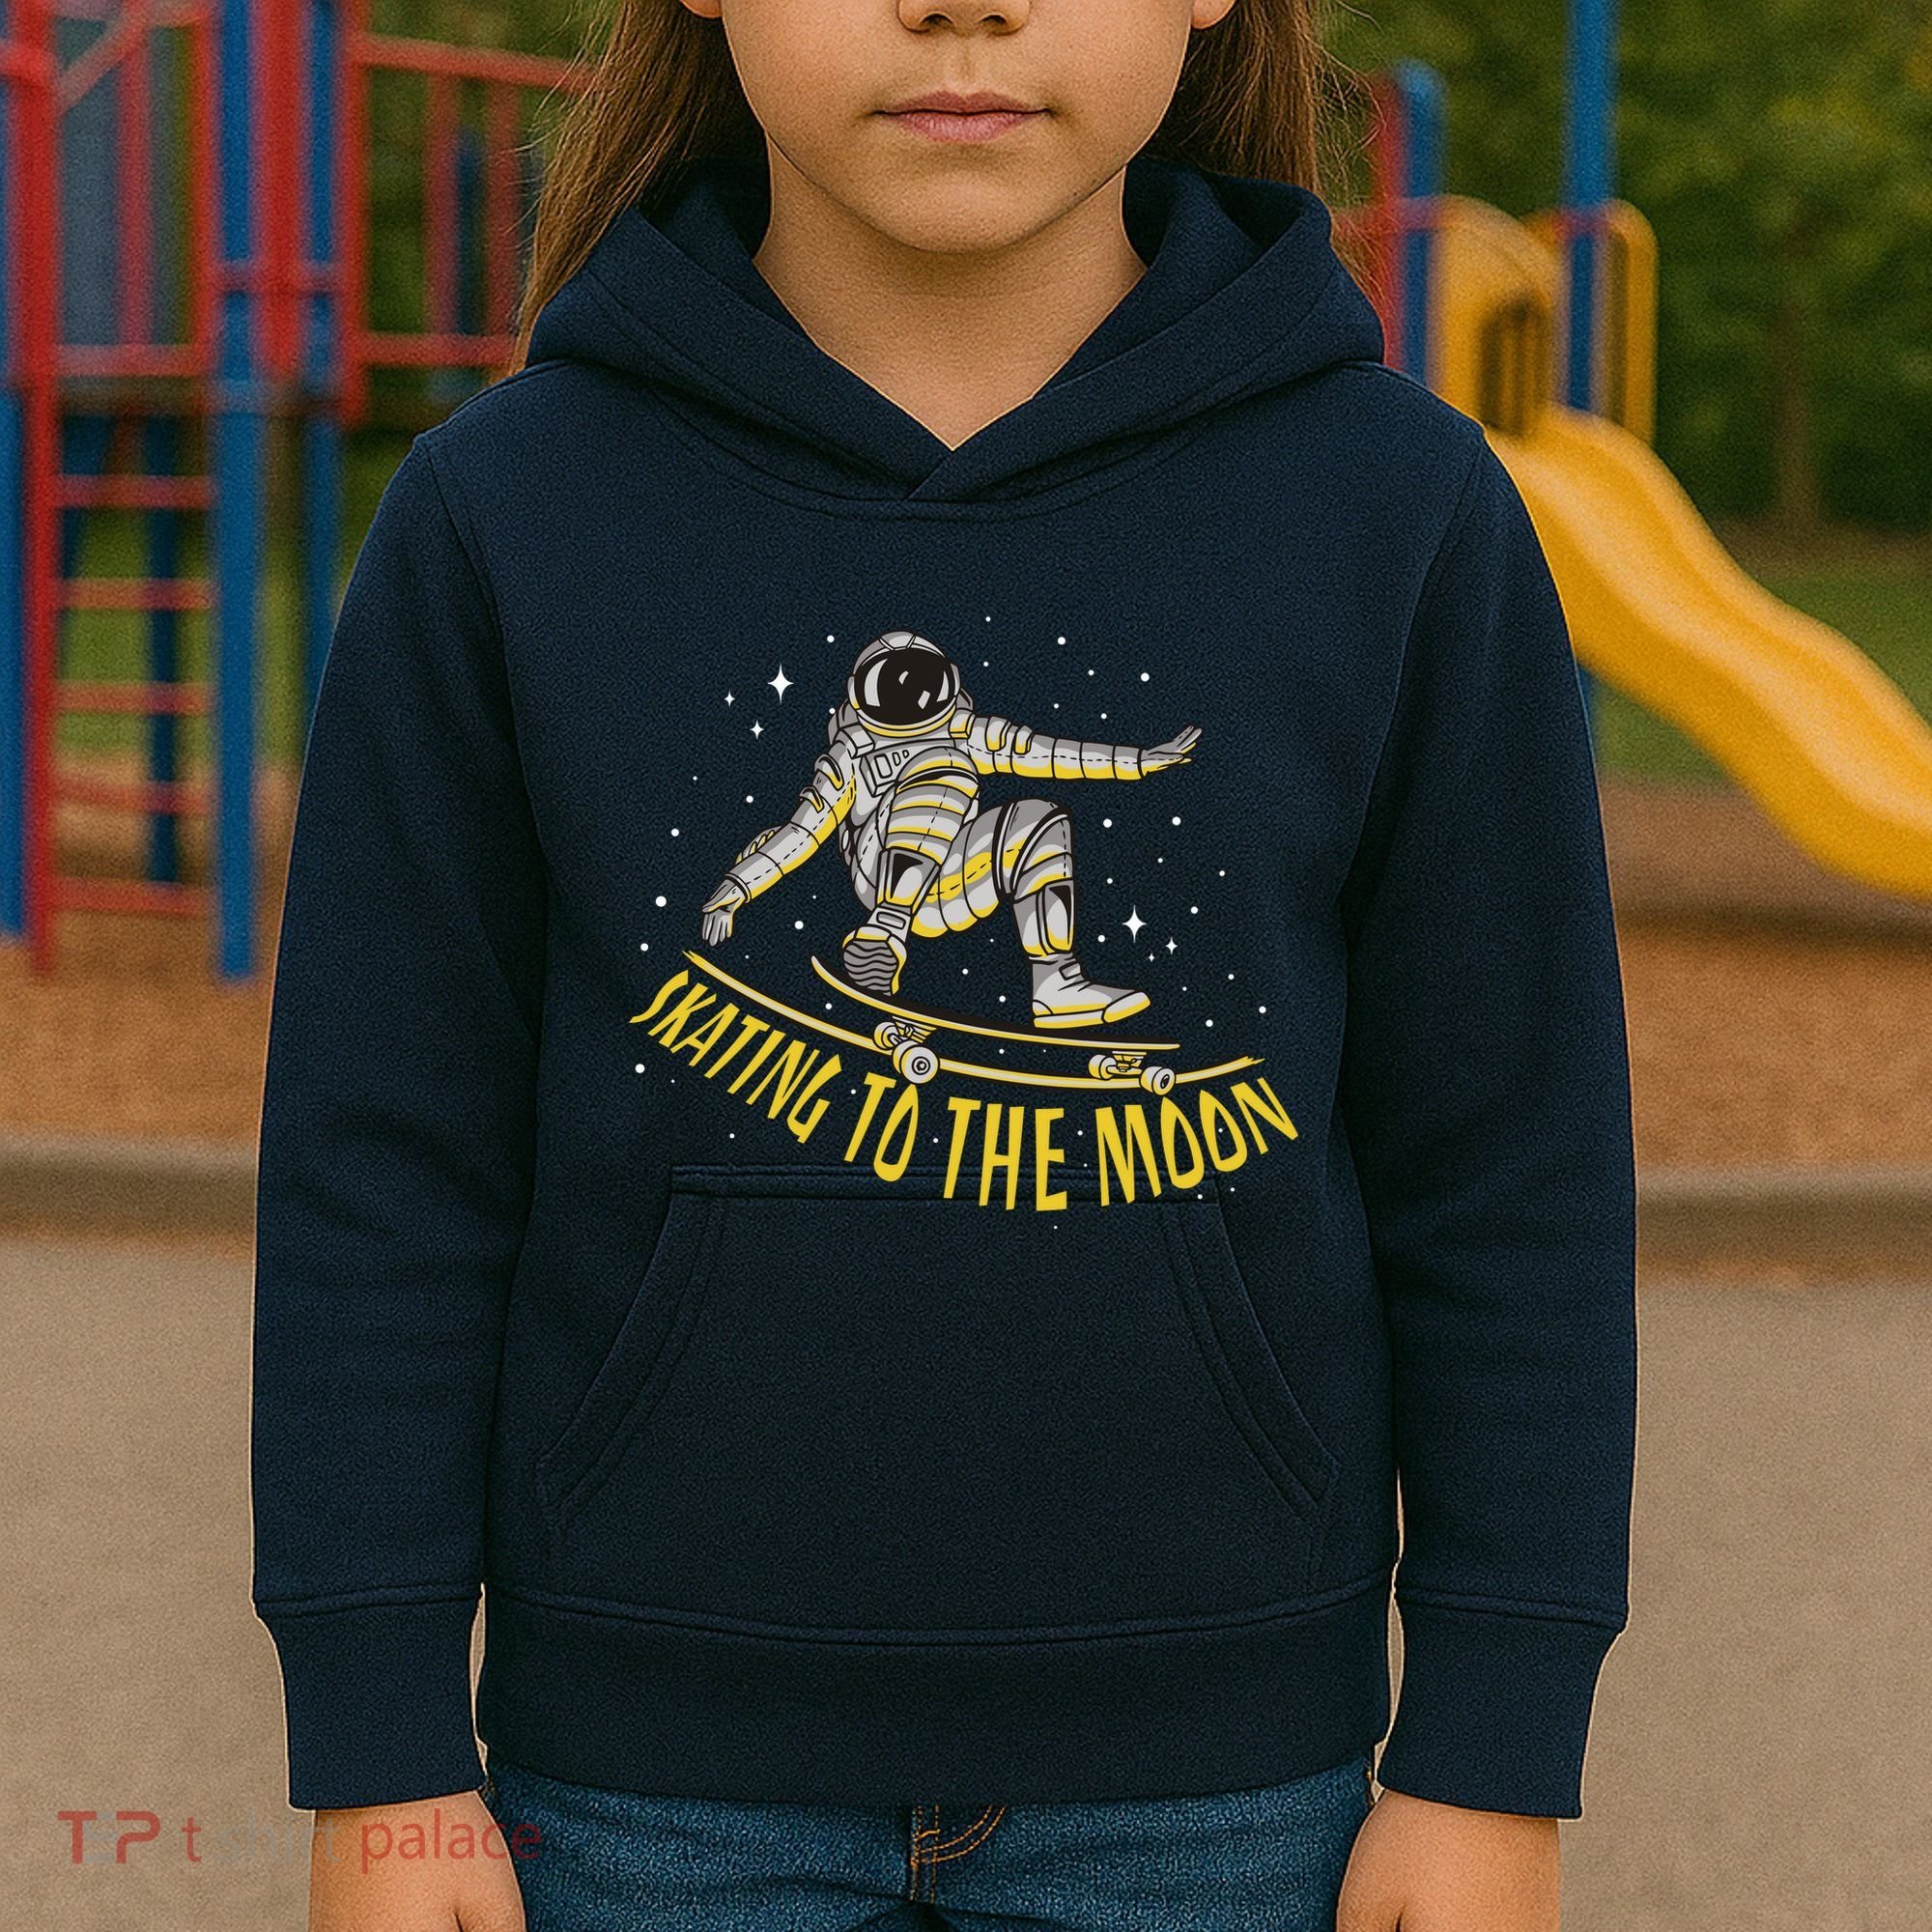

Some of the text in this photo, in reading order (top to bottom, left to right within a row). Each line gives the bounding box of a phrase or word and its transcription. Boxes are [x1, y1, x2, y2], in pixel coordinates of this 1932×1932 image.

[630, 970, 1299, 1211] SKATING TO THE MOON
